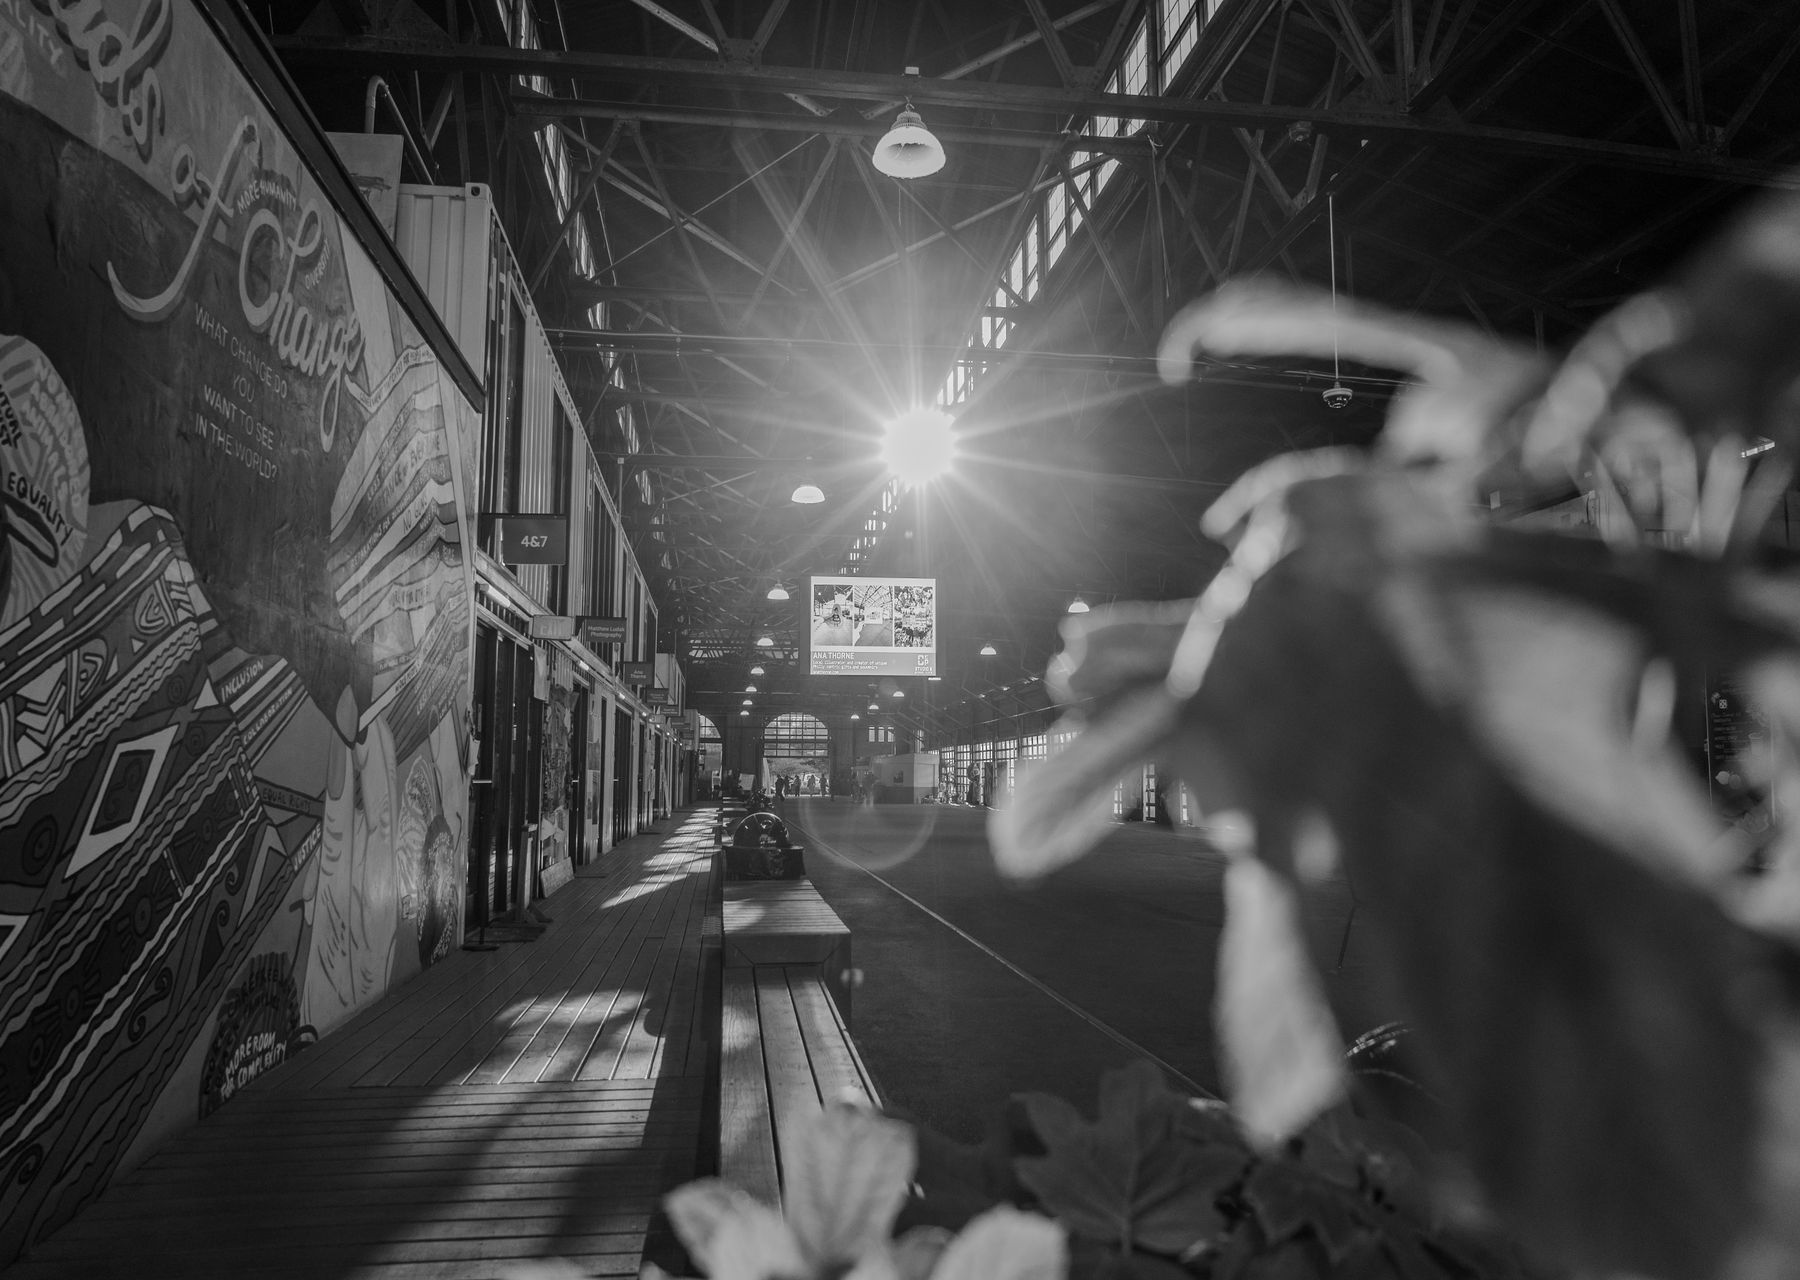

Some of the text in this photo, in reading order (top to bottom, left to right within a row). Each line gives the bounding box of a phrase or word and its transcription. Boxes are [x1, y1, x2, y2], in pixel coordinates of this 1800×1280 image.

[236, 179, 297, 214] MORE HUMANITY
[194, 301, 288, 400] WHAT CHANGE DO
[238, 199, 366, 453] Change
[233, 374, 256, 403] YOU
[203, 384, 275, 450] WANT TO SEE
[194, 412, 278, 480] IN THE WORLD?
[7, 472, 74, 547] EQUALITY
[520, 535, 548, 548] 4&7
[220, 659, 265, 702] INCLUSION
[828, 652, 855, 660] THORNE
[242, 687, 295, 744] COLLABORATION
[261, 788, 312, 812] EQUAL RIGHTS
[292, 822, 322, 872] JUSTICE
[220, 1076, 235, 1103] FOR
[237, 1039, 287, 1089] COMPLEXITY
[224, 1034, 254, 1082] MORE
[253, 1031, 276, 1055] ROOM
